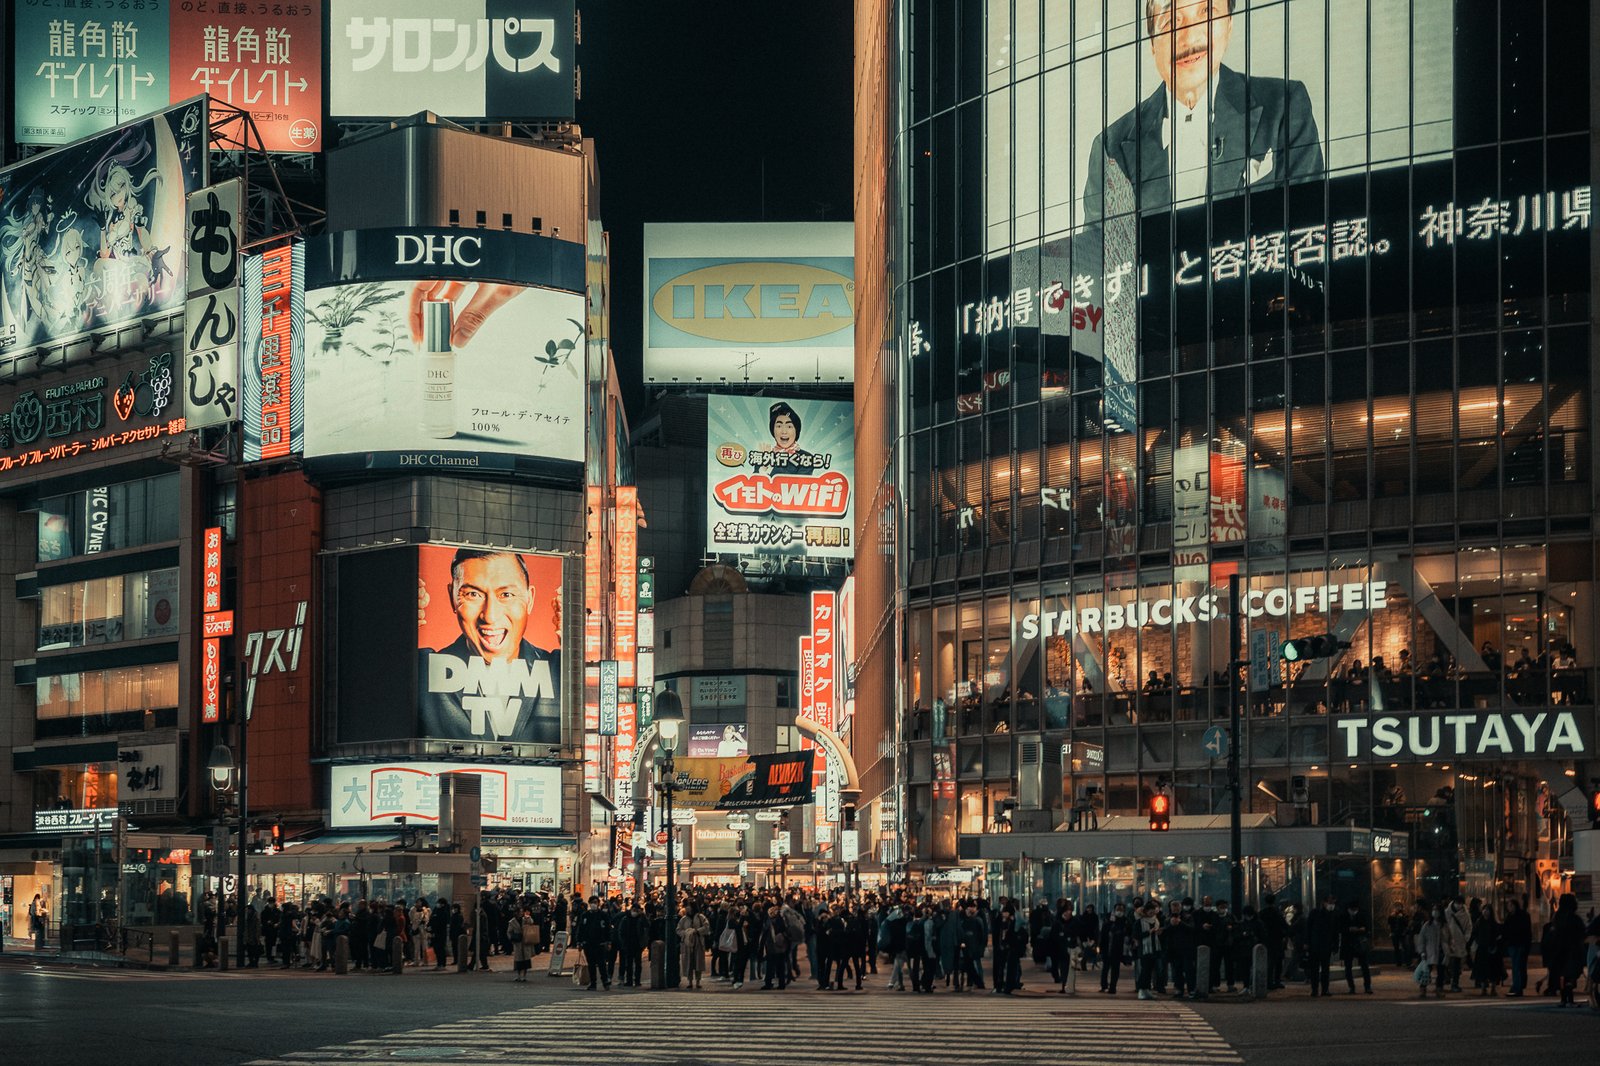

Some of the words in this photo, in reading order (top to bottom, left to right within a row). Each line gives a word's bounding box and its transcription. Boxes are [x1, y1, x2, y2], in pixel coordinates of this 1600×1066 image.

[181, 2, 312, 16] のど、直接、うるおう
[48, 19, 139, 59] 龍角散
[203, 25, 292, 64] 龍角散
[345, 16, 560, 74] サロンパス
[35, 62, 156, 100] ダイレクト
[190, 67, 309, 106] ダイレクト
[51, 105, 97, 115] スティック
[291, 128, 315, 139] 生薬
[395, 234, 482, 267] DHC
[190, 192, 238, 417] もんじゃ
[672, 283, 853, 319] IKEA
[261, 256, 283, 445] 三千里薬品
[45, 393, 103, 438] 西村
[472, 422, 500, 432] 100%
[400, 454, 427, 466] DHC
[429, 455, 479, 466] Channel
[721, 447, 742, 460] 再び
[721, 477, 843, 508] イモトのWiFi
[87, 511, 108, 554] CAME
[1021, 594, 1219, 640] STARBUCKS
[1241, 580, 1388, 618] COFFEE
[814, 604, 833, 692] カラオケ
[428, 653, 555, 699] DMM
[462, 696, 523, 742] TV
[1337, 711, 1585, 758] TSUTAYA
